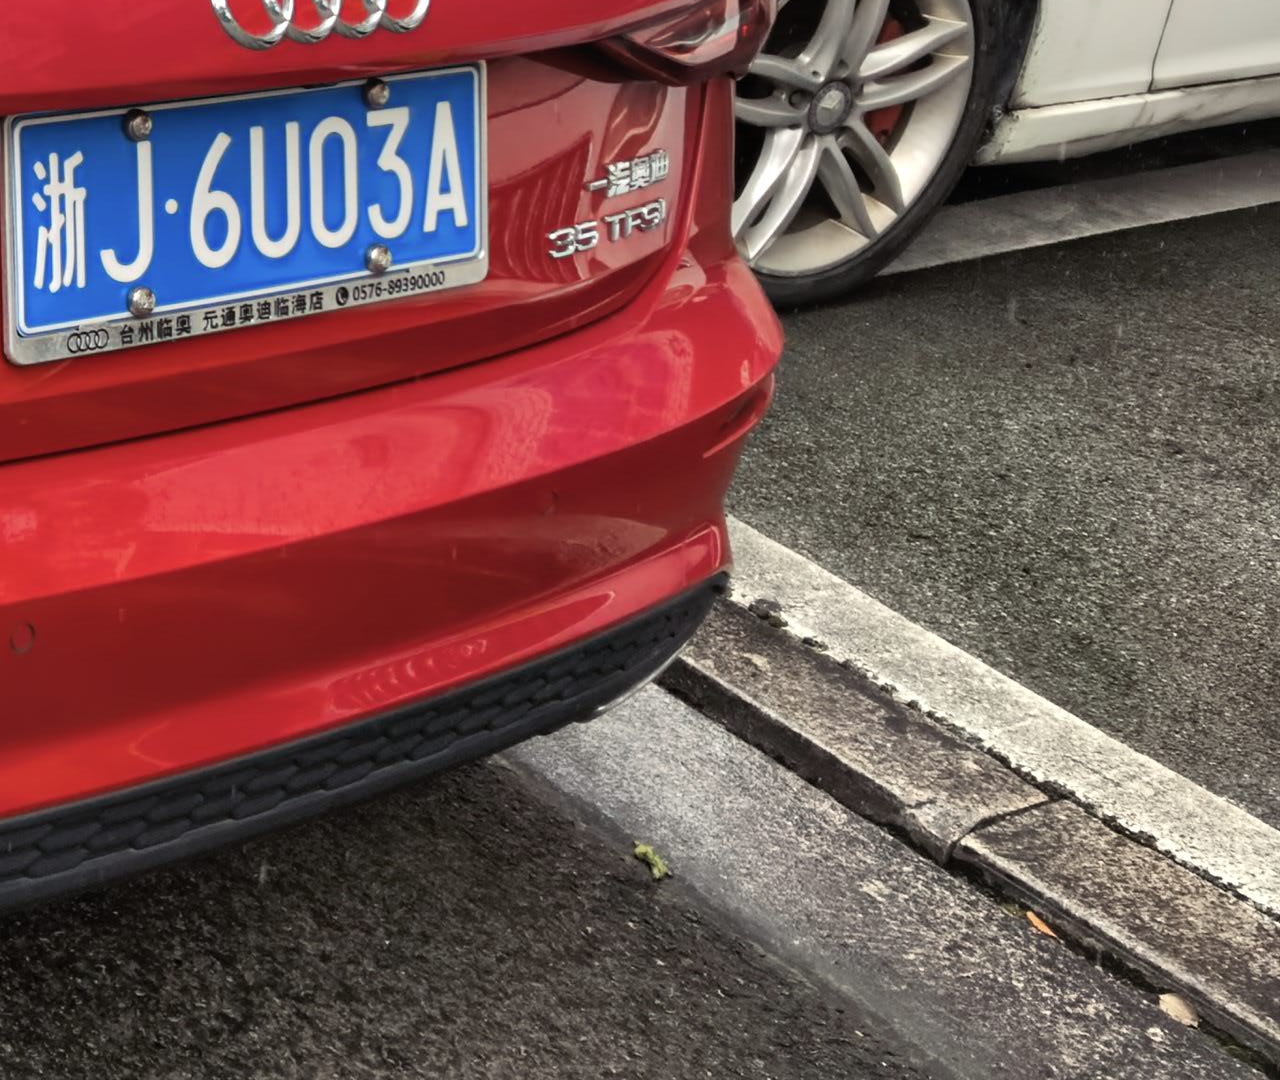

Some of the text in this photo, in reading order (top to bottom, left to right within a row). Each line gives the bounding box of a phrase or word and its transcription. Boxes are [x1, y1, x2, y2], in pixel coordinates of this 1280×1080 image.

[585, 149, 670, 198] 一汽奥迪
[547, 199, 666, 258] 35 TFSI
[119, 270, 446, 346] 台州临奥 元通奥迪临海店 0576-89390000
